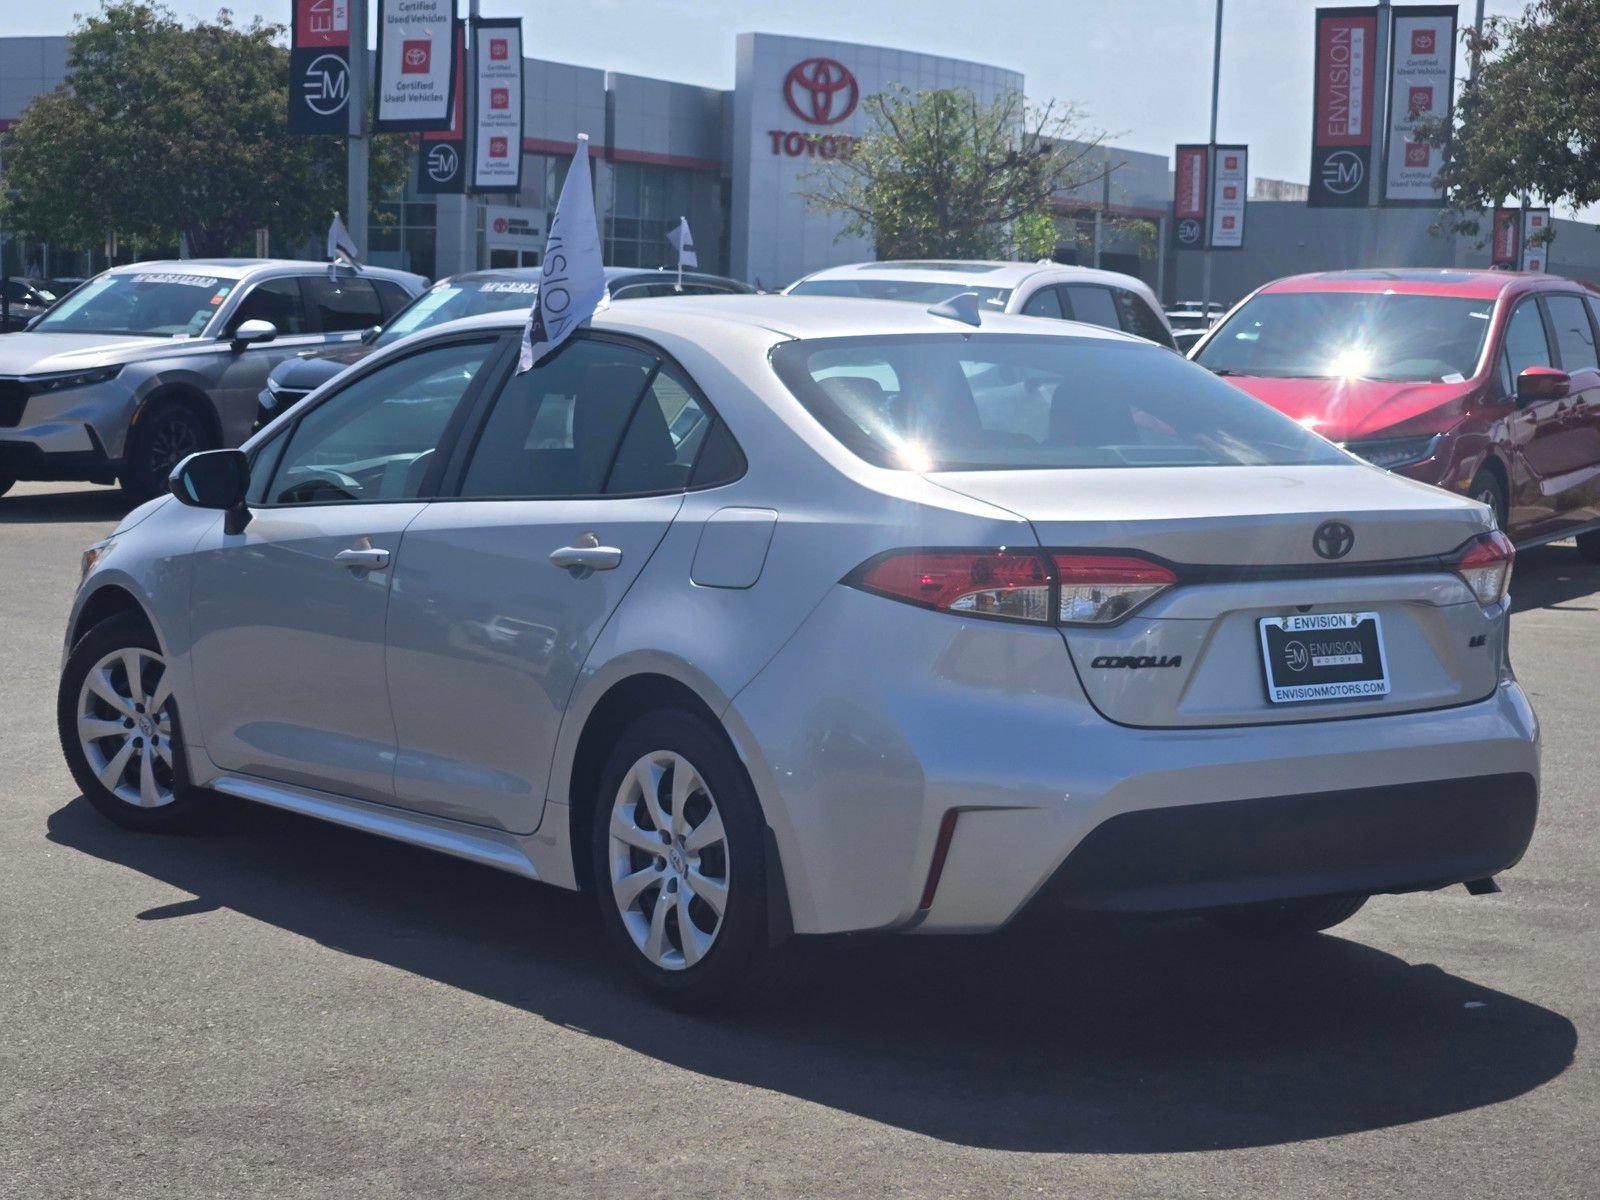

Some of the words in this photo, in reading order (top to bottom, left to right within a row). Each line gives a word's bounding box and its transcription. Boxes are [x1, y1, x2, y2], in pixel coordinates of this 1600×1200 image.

[399, 1, 436, 11] Certified
[388, 15, 410, 24] Used
[411, 14, 447, 24] Vehicles
[396, 80, 433, 90] Certified
[1328, 27, 1350, 136] ENVISION
[384, 93, 406, 103] Used
[409, 92, 443, 102] Vehicles
[1294, 615, 1347, 630] ENVISION
[1468, 634, 1487, 648] LE
[1309, 641, 1362, 656] ENVISION
[1090, 655, 1182, 669] COROLLA
[1276, 682, 1386, 700] ENVISIONMOTORS.COM
